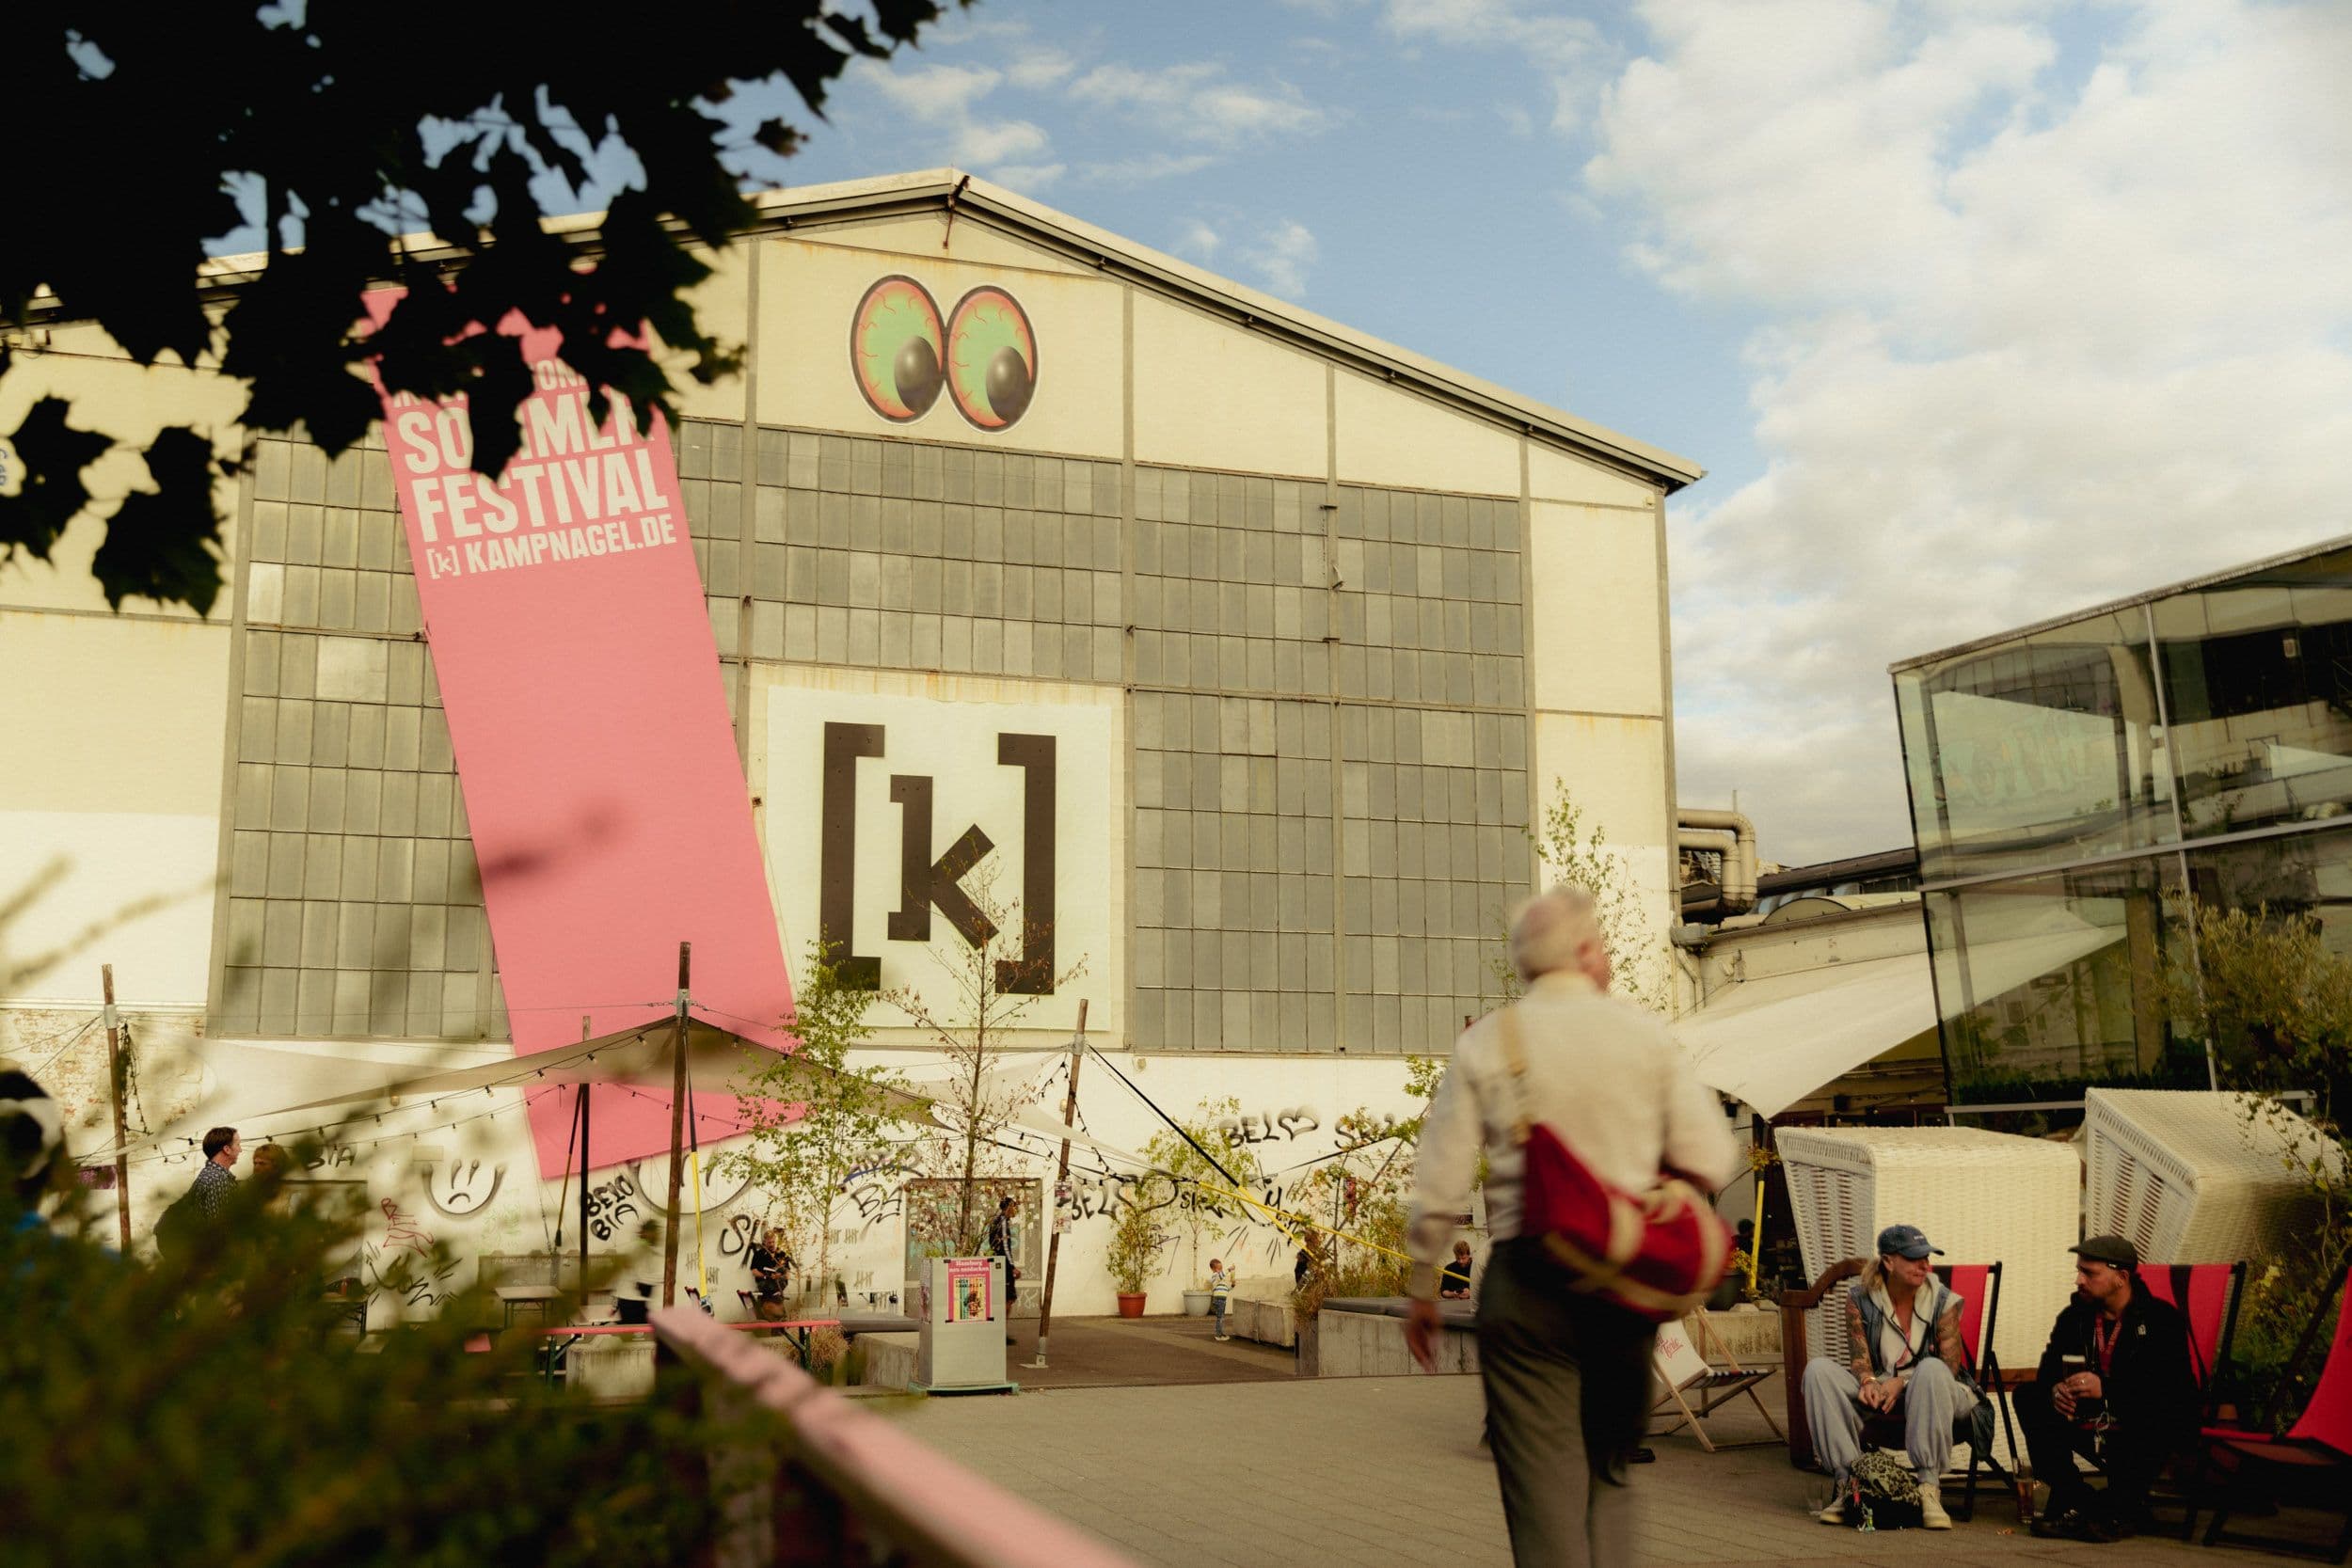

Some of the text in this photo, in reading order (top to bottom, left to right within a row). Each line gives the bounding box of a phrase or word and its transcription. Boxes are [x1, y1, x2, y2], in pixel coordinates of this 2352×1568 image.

[397, 387, 655, 474] SOM
[411, 448, 669, 543] FESTIVAL
[464, 513, 677, 575] KAMPNAGEL.DE
